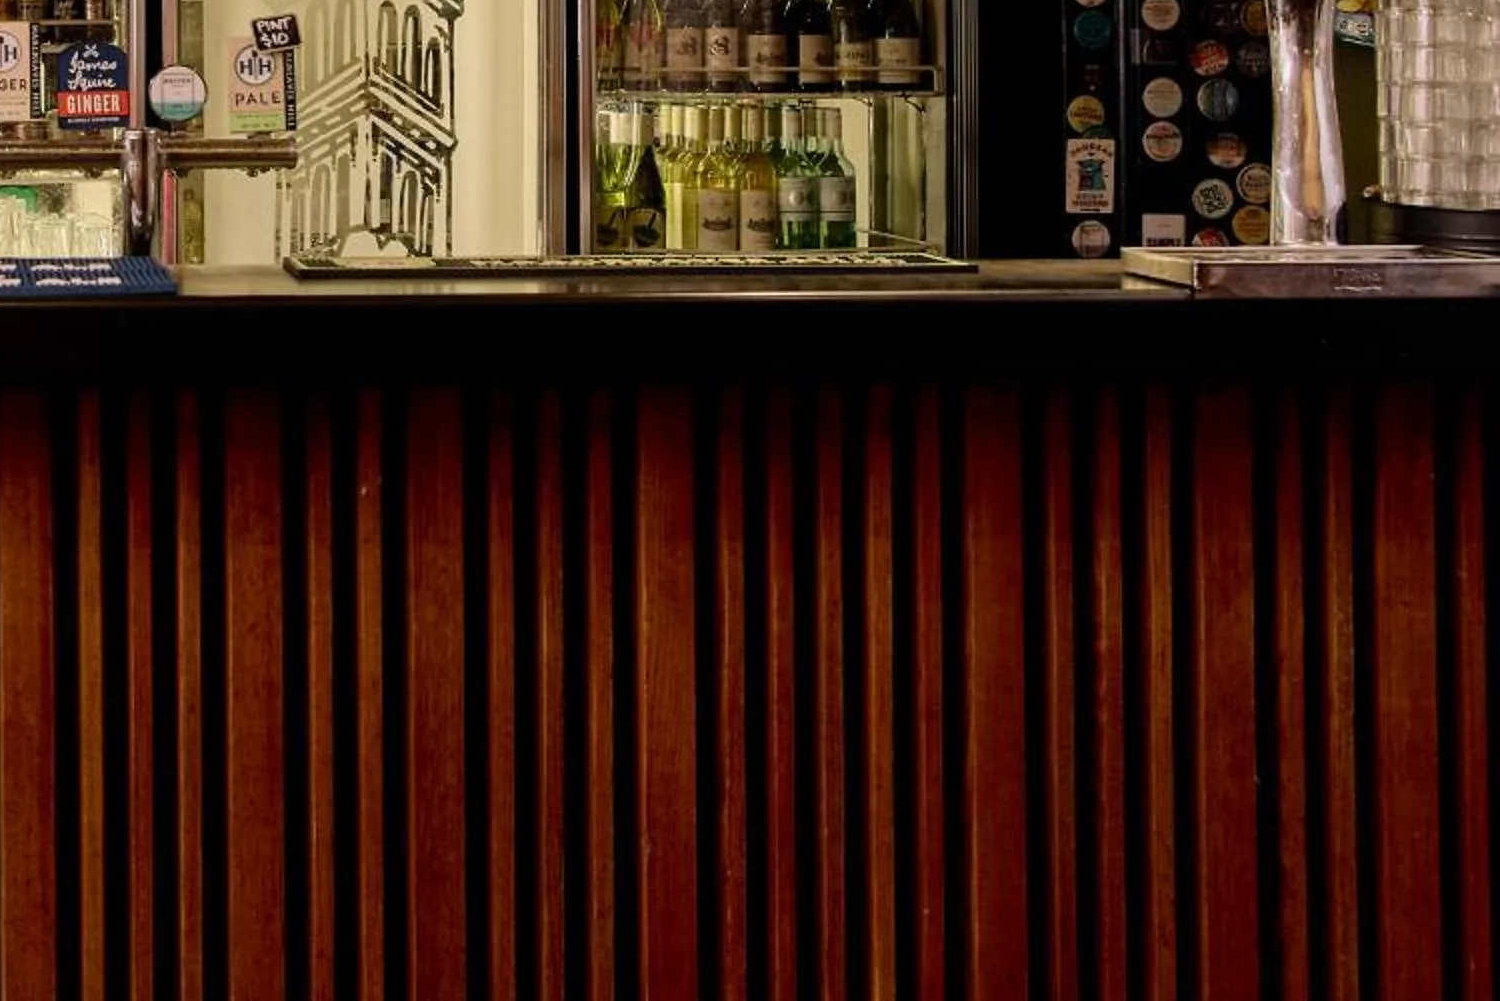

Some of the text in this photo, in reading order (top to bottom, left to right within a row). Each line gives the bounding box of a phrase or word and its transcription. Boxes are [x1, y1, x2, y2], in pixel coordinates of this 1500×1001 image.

[256, 17, 292, 33] PINT
[260, 33, 289, 48] $10
[68, 50, 118, 75] James
[67, 93, 121, 114] GINGER
[235, 90, 281, 107] PALE
